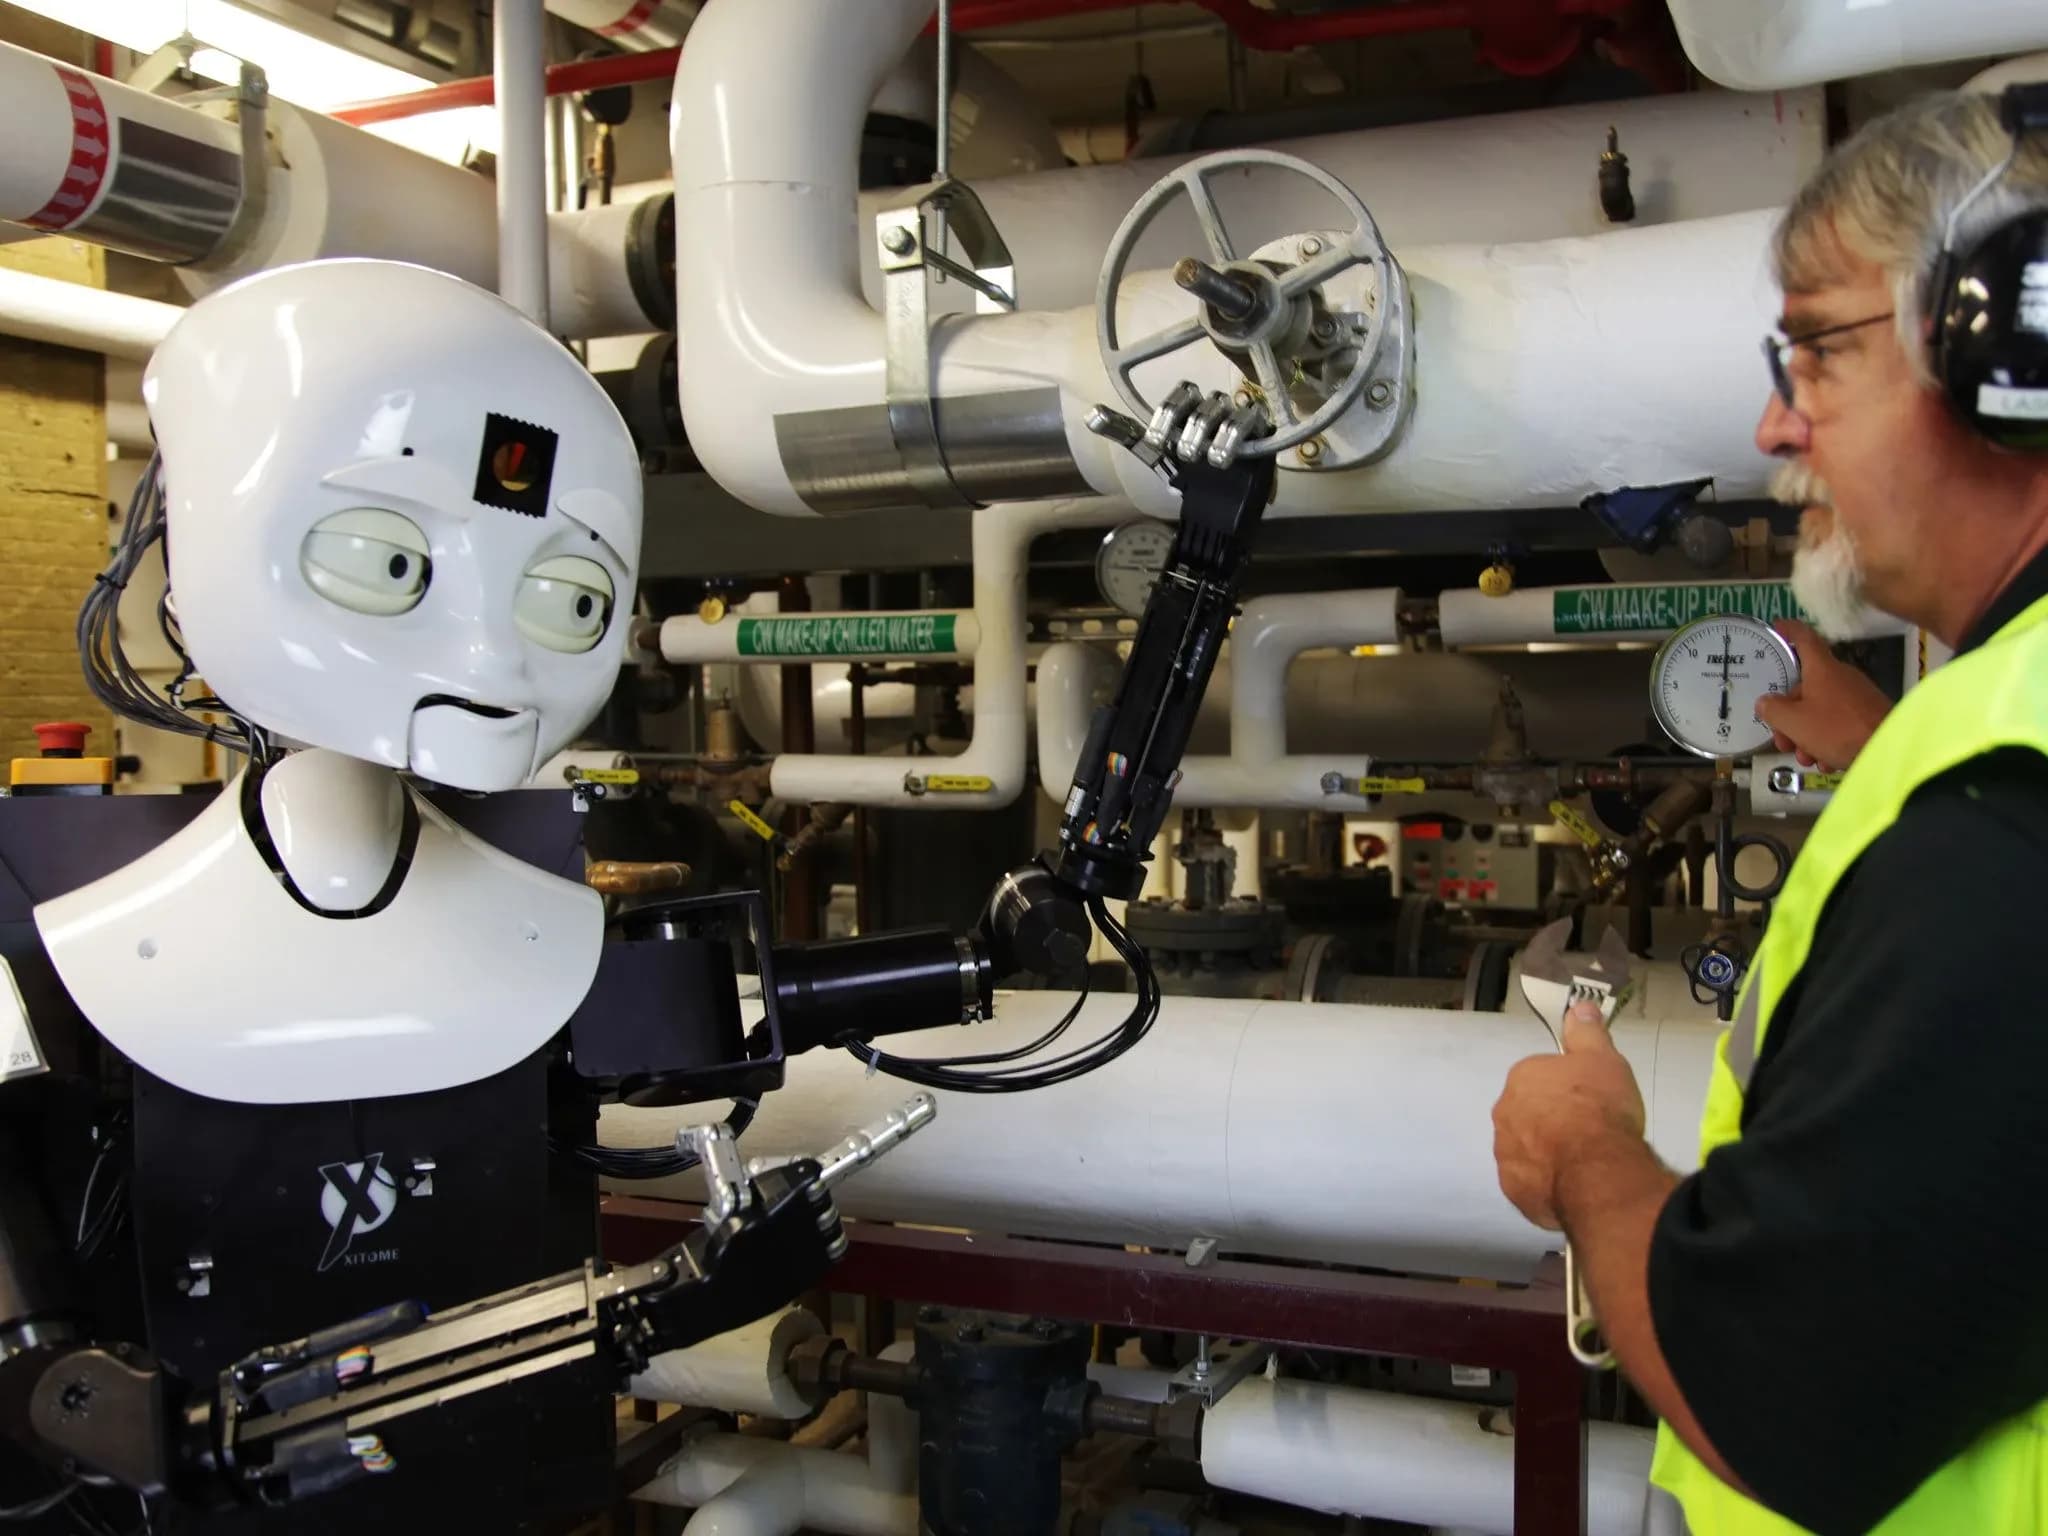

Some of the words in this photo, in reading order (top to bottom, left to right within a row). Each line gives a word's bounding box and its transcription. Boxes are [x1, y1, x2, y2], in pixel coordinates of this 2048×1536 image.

[1577, 587, 1609, 630] CW
[1612, 586, 1699, 630] MAKE-UP
[1702, 585, 1747, 618] HOT
[752, 620, 776, 654] CW
[776, 619, 831, 653] MAKE-UP
[832, 618, 886, 652] CHILLED
[888, 616, 936, 650] WATER
[1688, 648, 1698, 658] 10
[1754, 649, 1765, 659] 20
[1672, 681, 1679, 690] 5
[1768, 682, 1778, 691] 25
[10, 1050, 33, 1067] 28
[343, 1248, 400, 1267] XITOME
